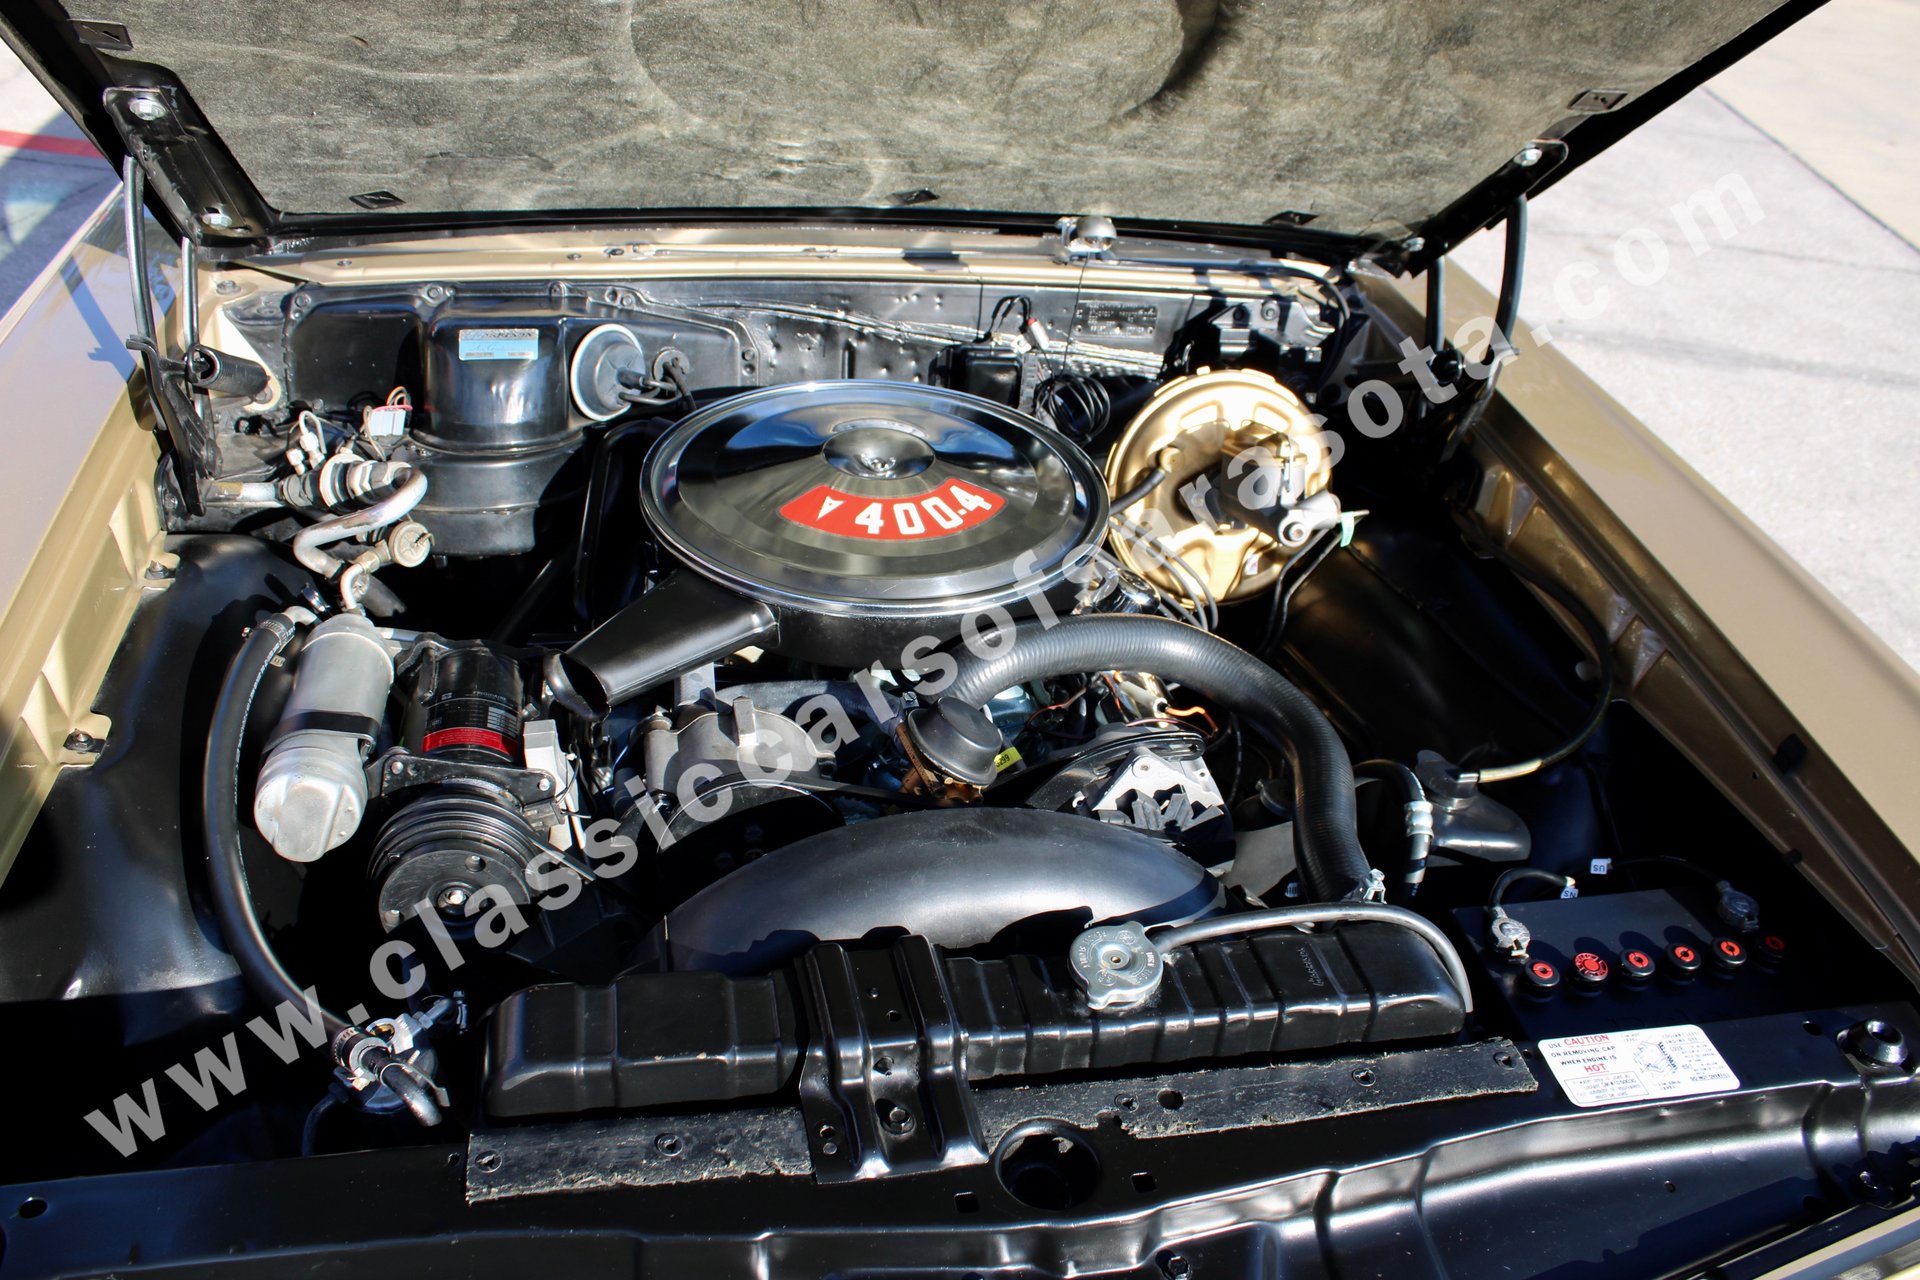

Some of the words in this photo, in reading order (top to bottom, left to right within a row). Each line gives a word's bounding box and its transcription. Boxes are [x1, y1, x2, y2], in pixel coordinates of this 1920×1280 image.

[1563, 1034, 1610, 1046] CAUTION
[1563, 1047, 1600, 1056] REMOVING
[1582, 1055, 1608, 1064] ENGINE
[1584, 1063, 1607, 1073] HOT
